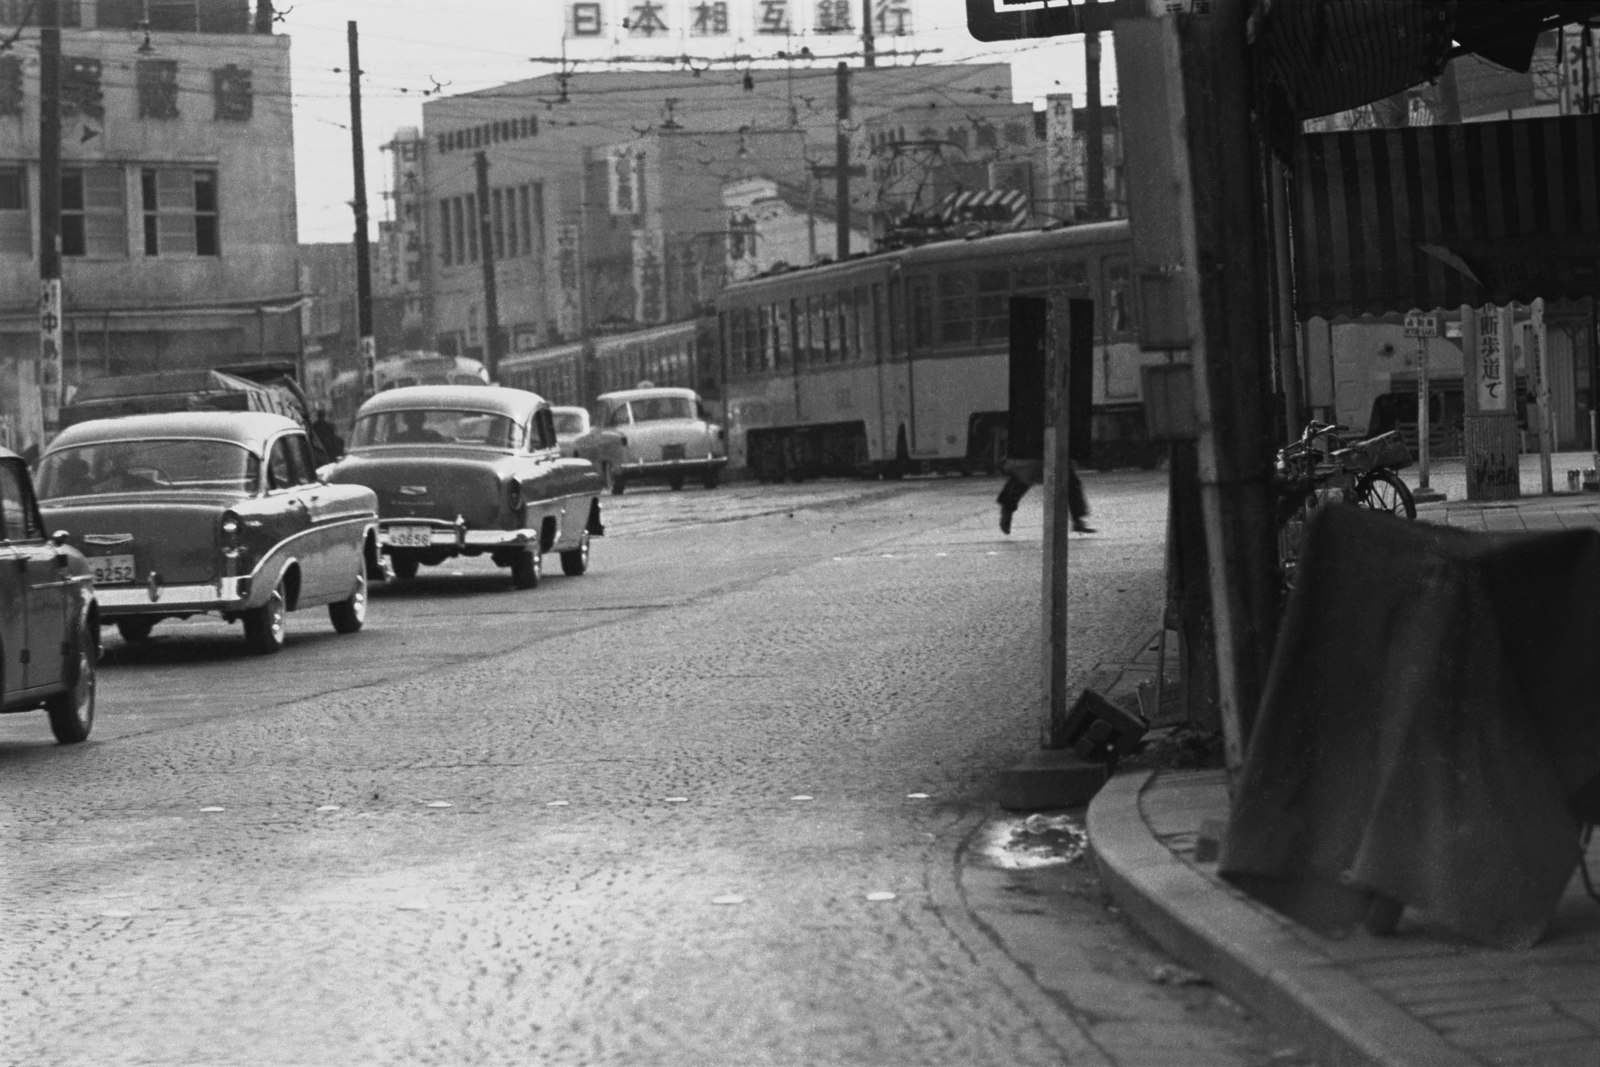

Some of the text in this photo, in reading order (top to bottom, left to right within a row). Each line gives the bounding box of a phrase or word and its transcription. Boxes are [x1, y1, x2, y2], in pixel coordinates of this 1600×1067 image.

[573, 0, 911, 36] 日本相互銀行
